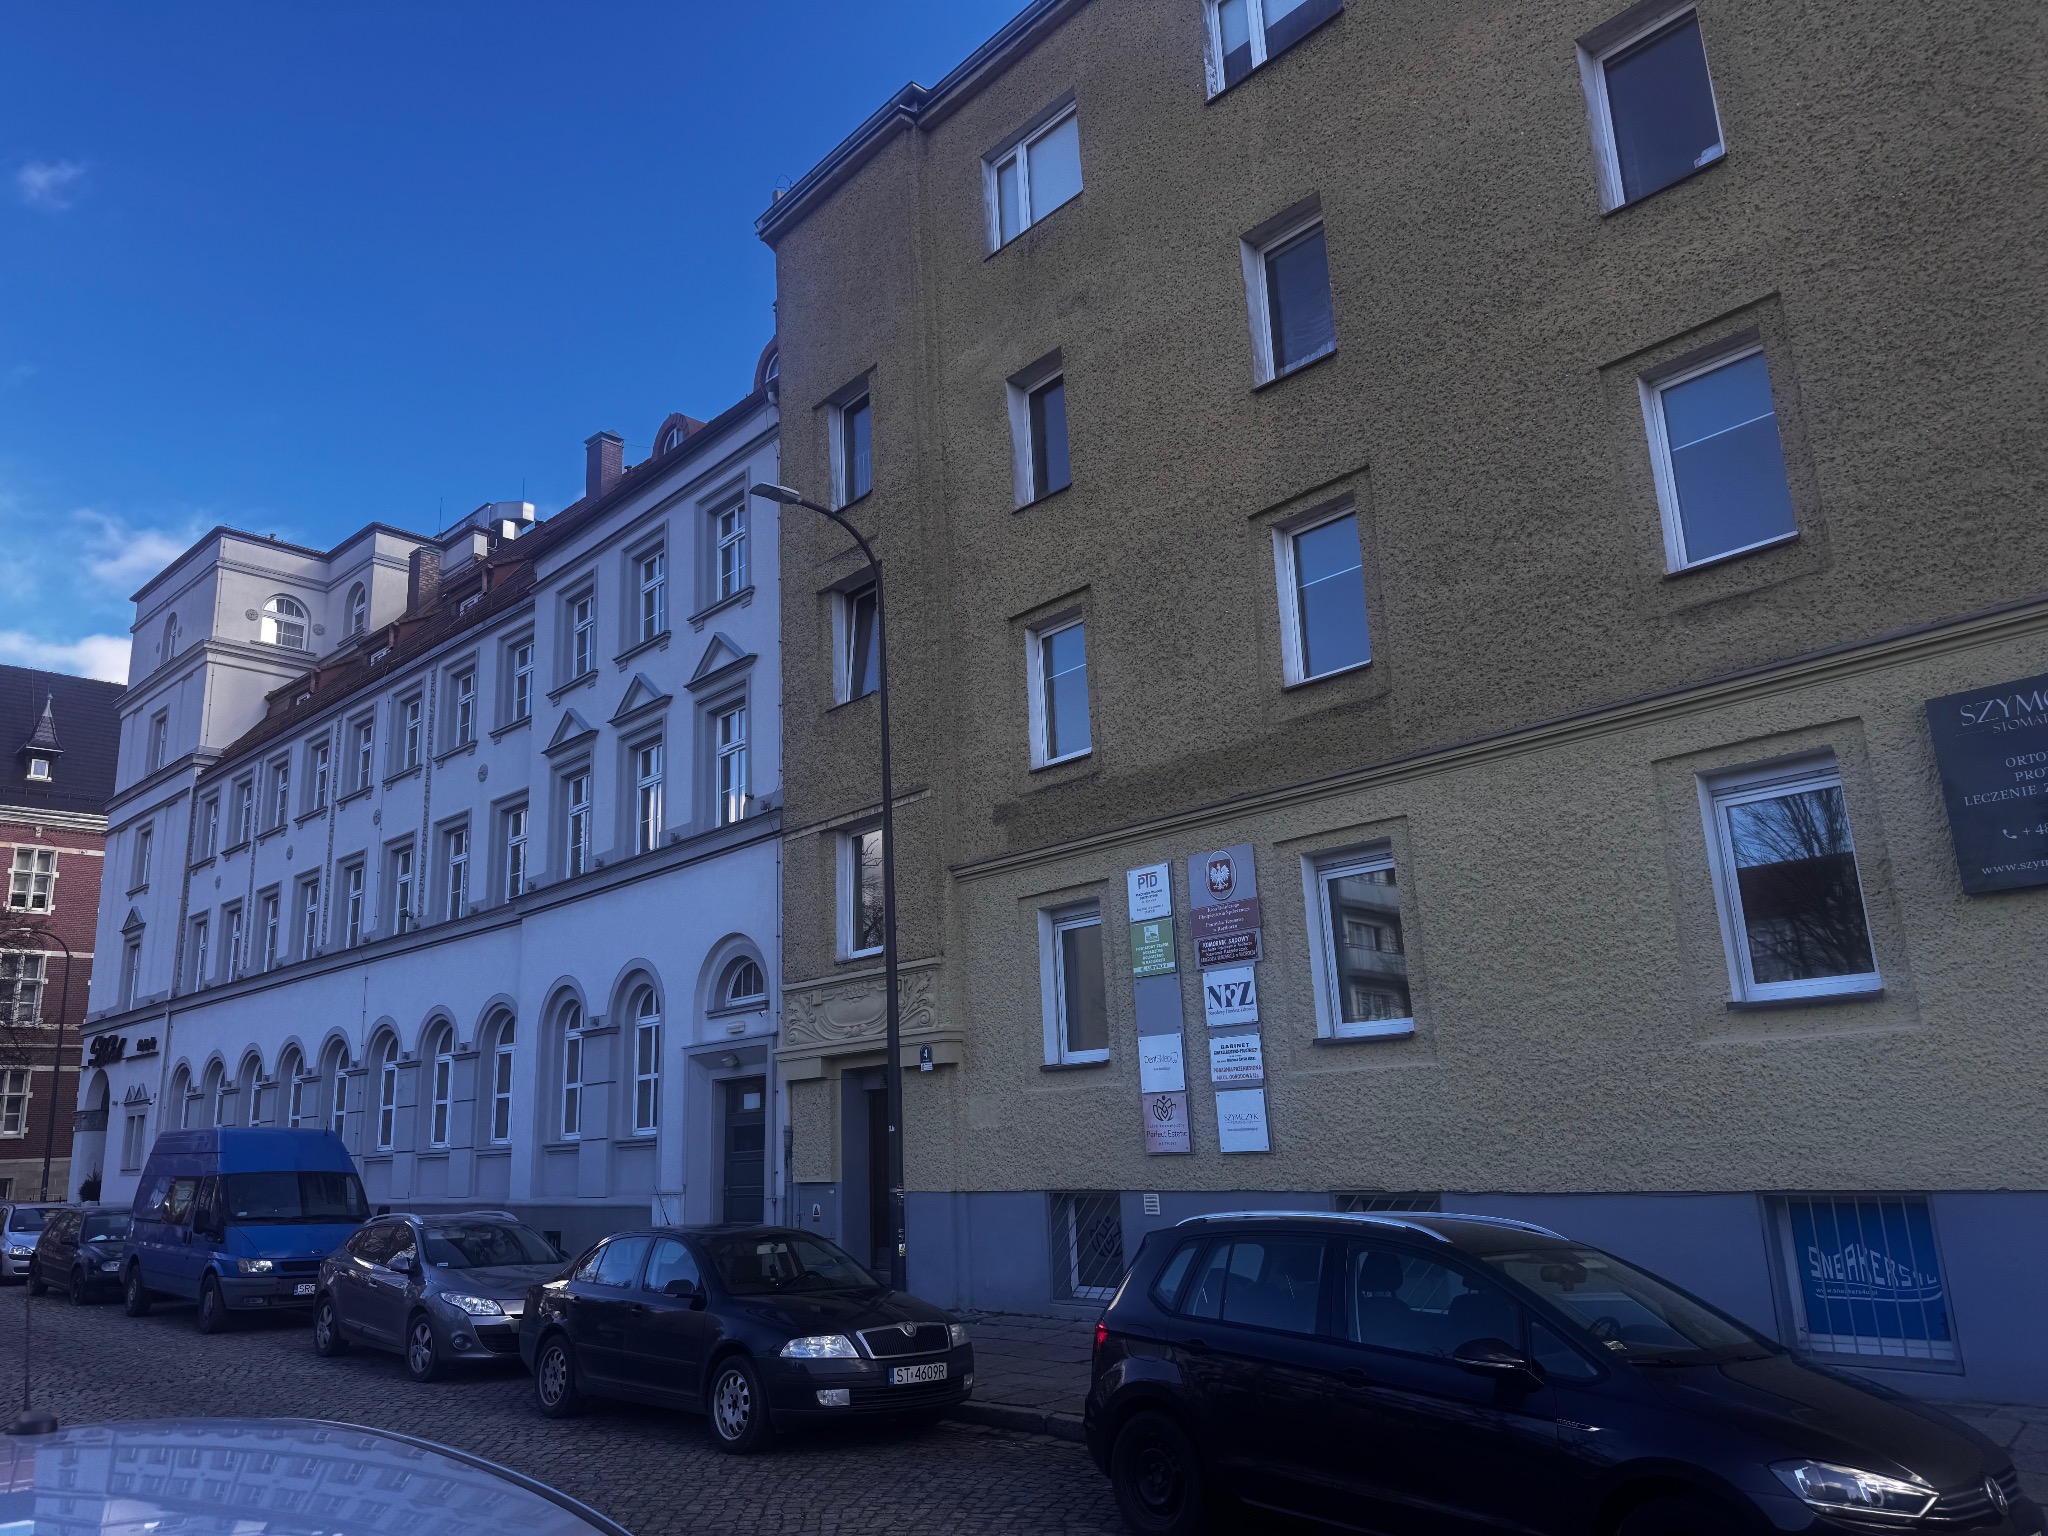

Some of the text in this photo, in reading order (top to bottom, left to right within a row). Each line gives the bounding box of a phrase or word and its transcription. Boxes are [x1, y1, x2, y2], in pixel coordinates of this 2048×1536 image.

[2006, 750, 2048, 767] ORTO
[1964, 785, 2037, 806] LECZENIE
[1138, 871, 1157, 889] PTD
[1207, 981, 1254, 1009] NFZ
[897, 1365, 945, 1383] ST 4609R
